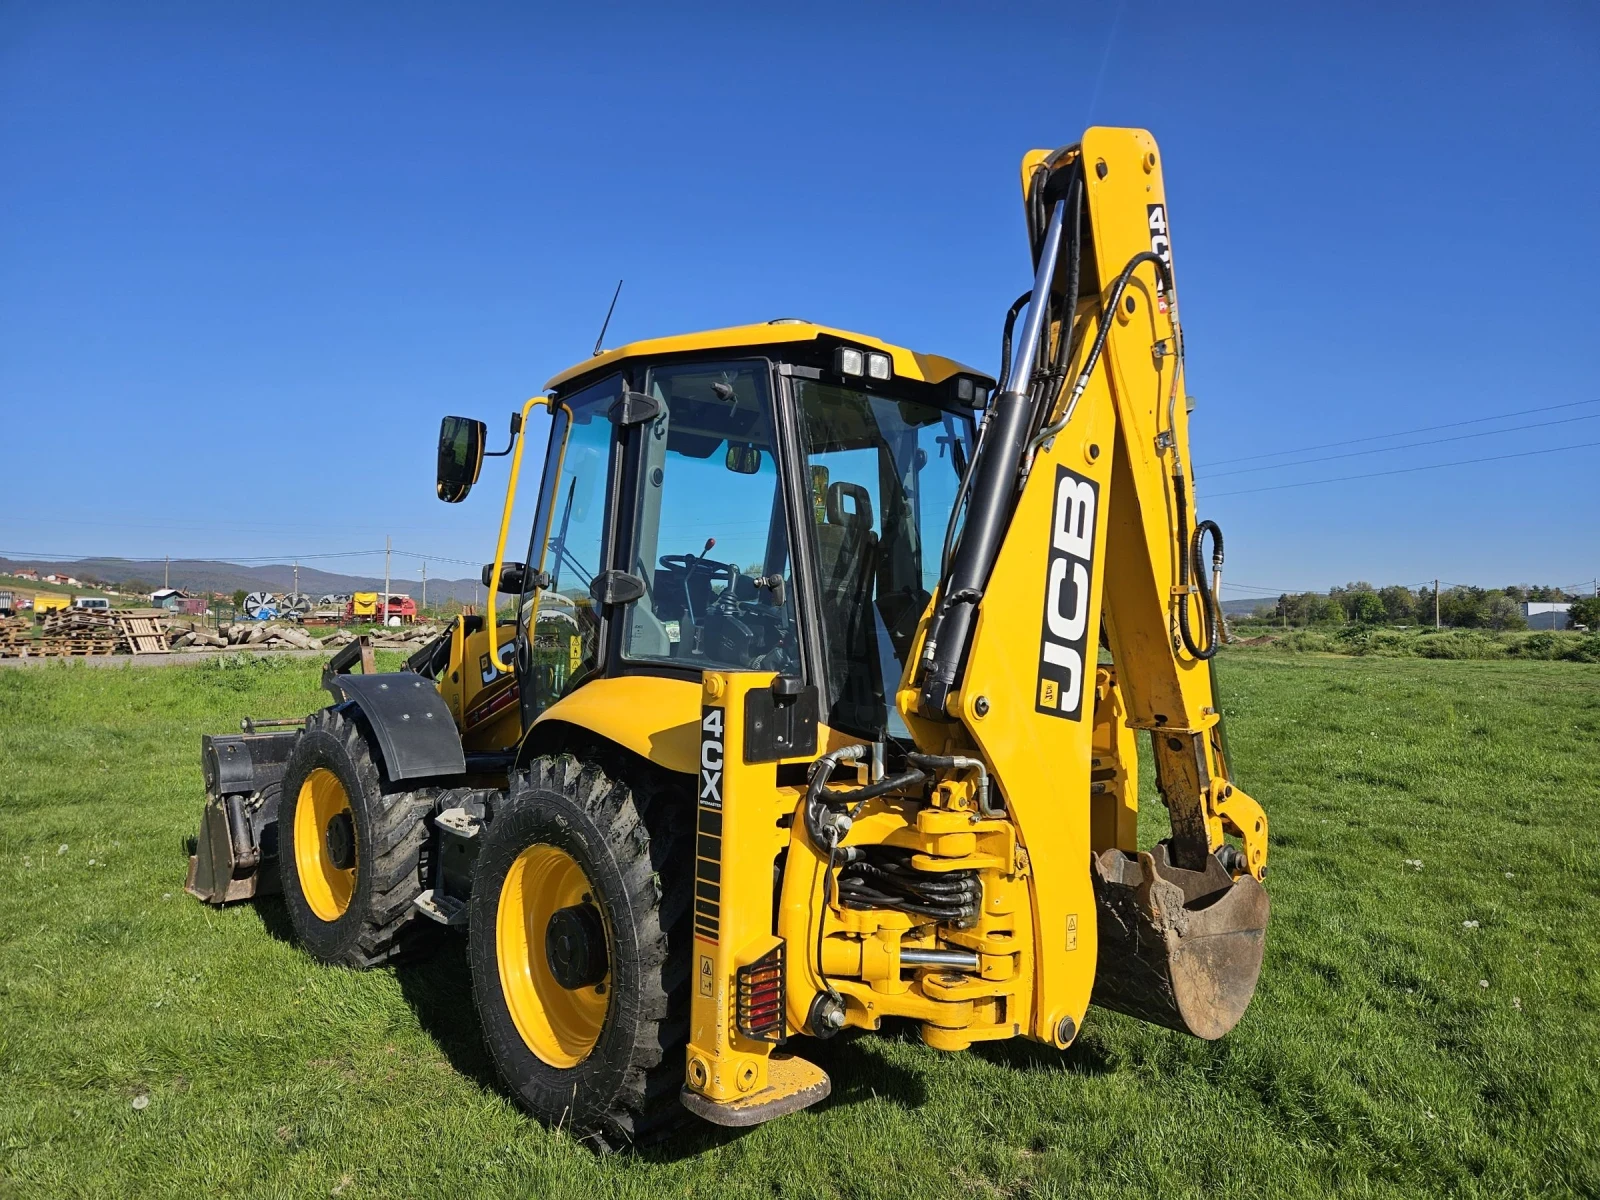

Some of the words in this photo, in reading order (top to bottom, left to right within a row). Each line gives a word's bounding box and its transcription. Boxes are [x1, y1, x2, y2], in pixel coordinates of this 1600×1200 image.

[1149, 206, 1171, 292] 4C
[1043, 476, 1096, 713] JCB
[482, 642, 517, 683] JC
[700, 709, 723, 802] 4CX
